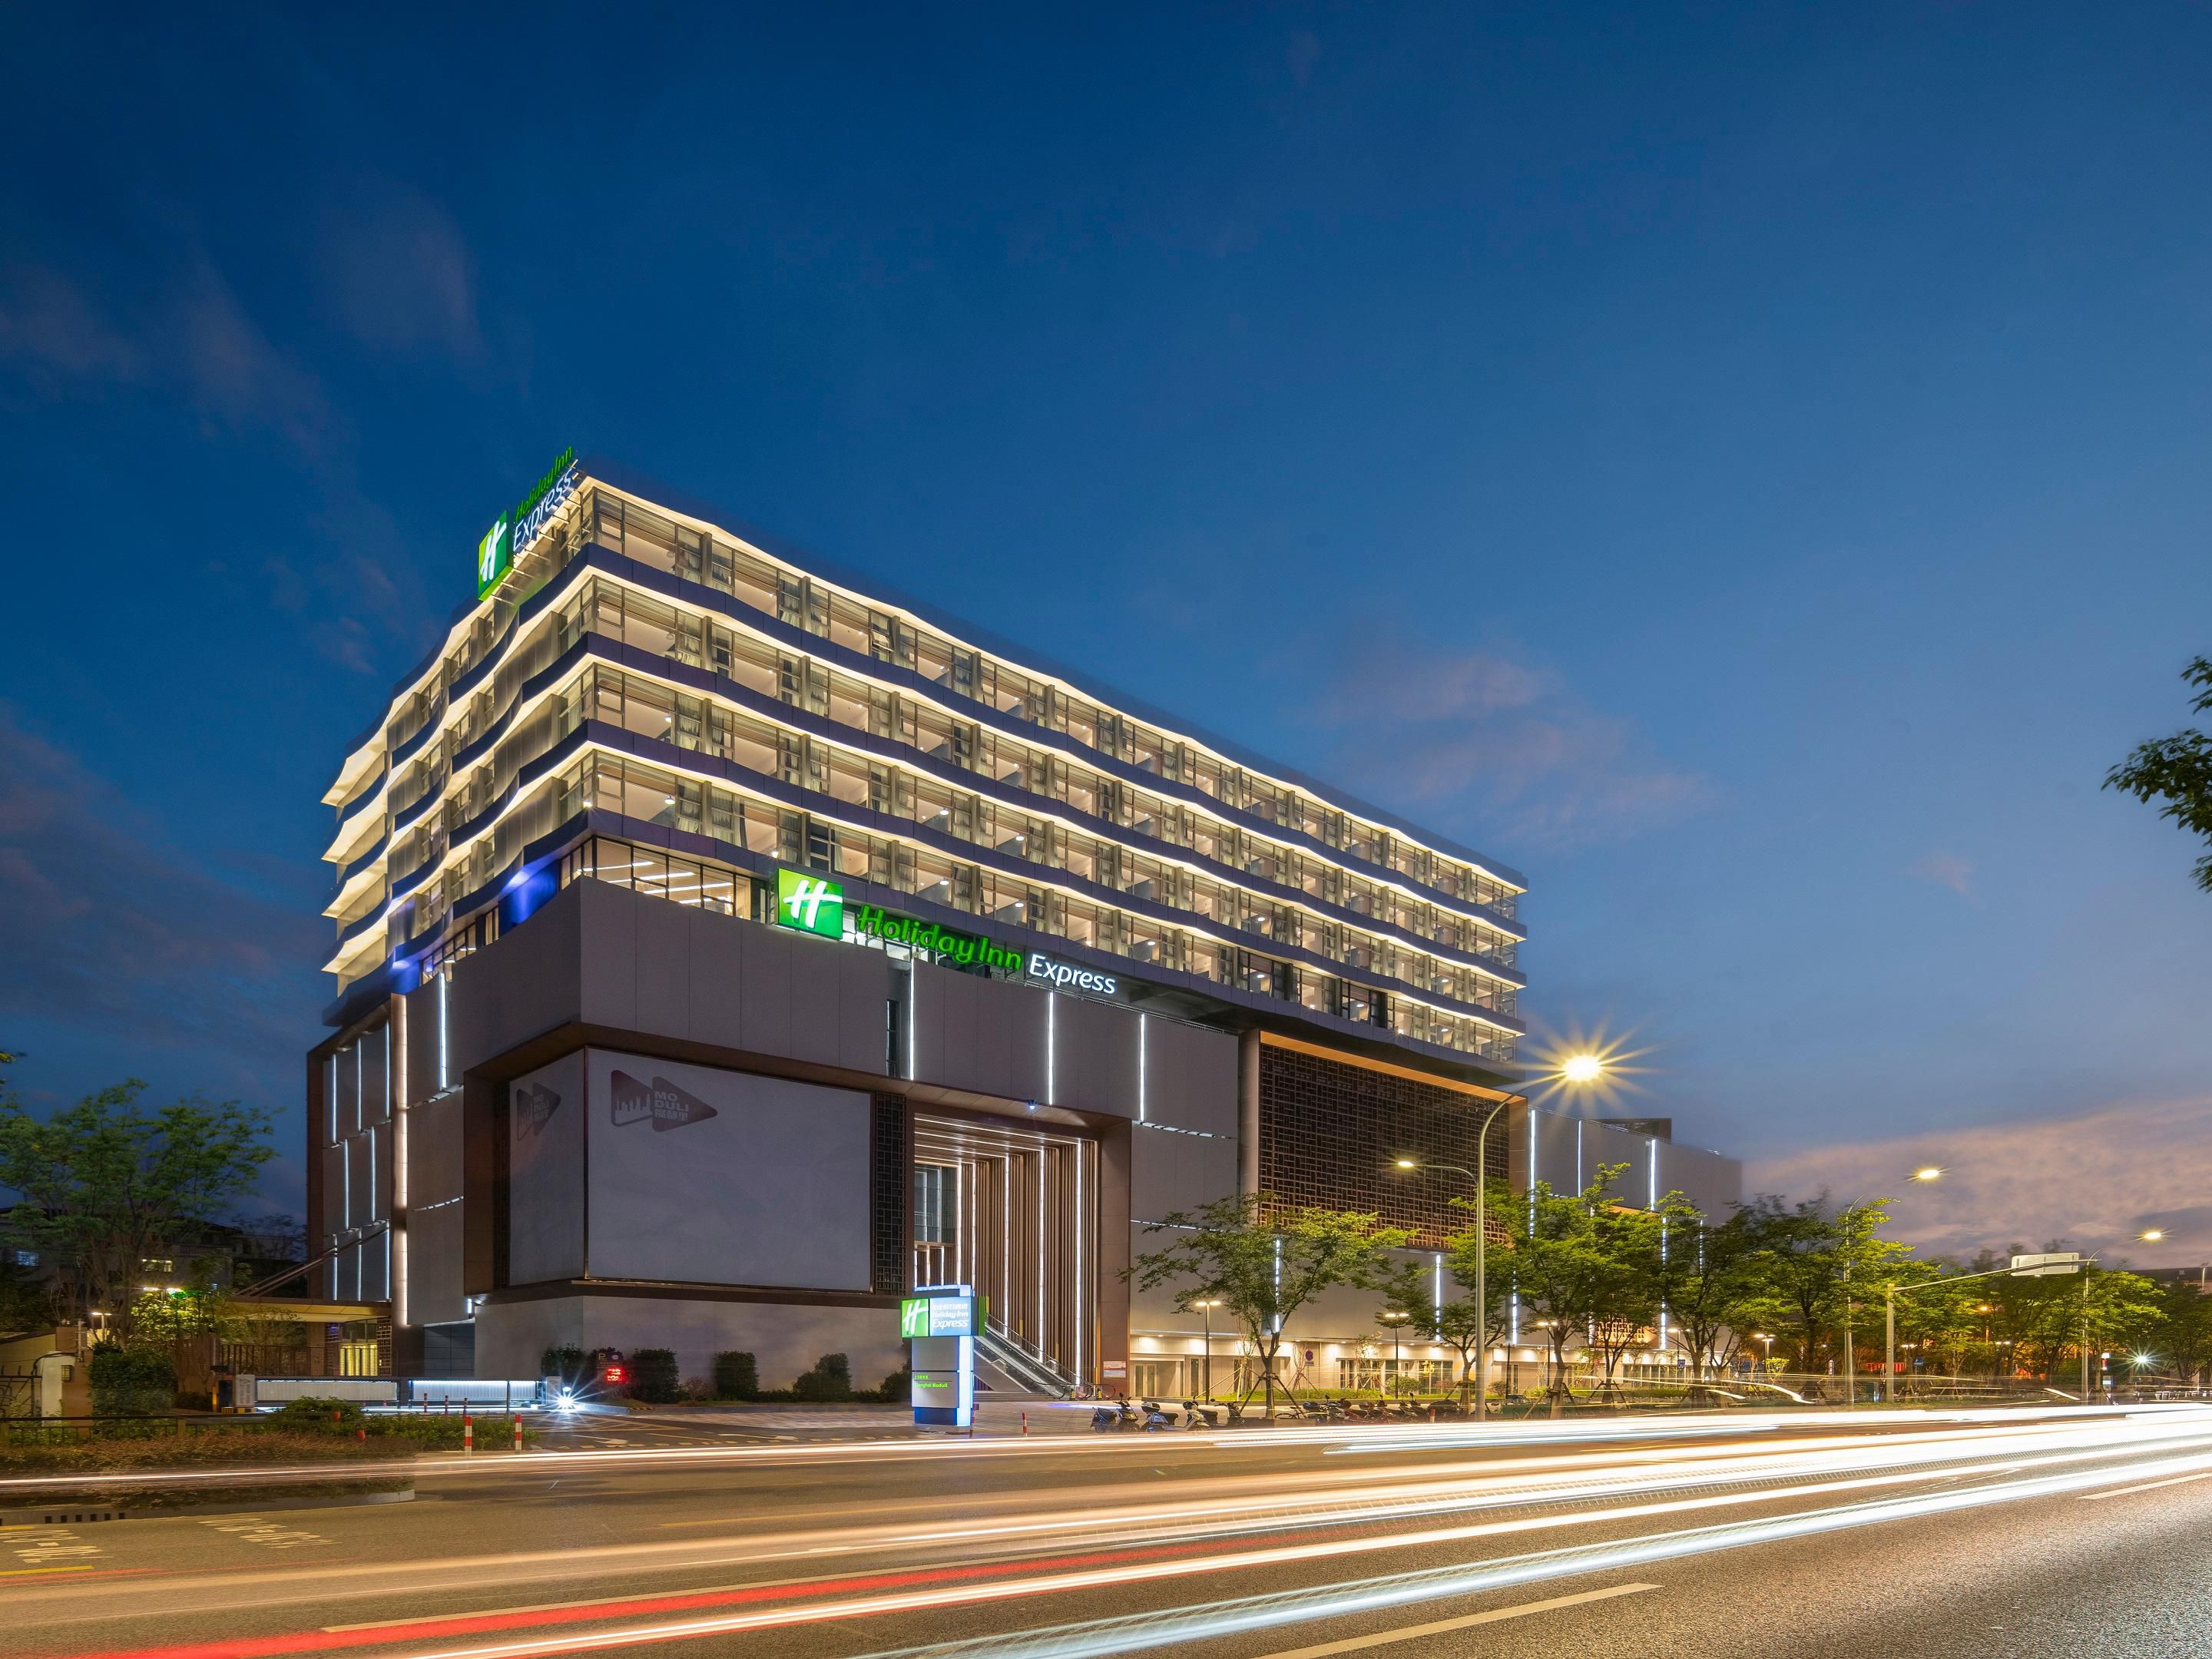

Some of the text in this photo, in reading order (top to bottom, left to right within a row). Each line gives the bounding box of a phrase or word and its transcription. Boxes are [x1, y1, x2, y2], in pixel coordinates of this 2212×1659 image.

[513, 468, 573, 552] Express
[856, 904, 1116, 994] Holiday Inn Express
[654, 1091, 677, 1101] MO
[654, 1099, 689, 1112] DULI
[932, 1319, 969, 1330] Express
